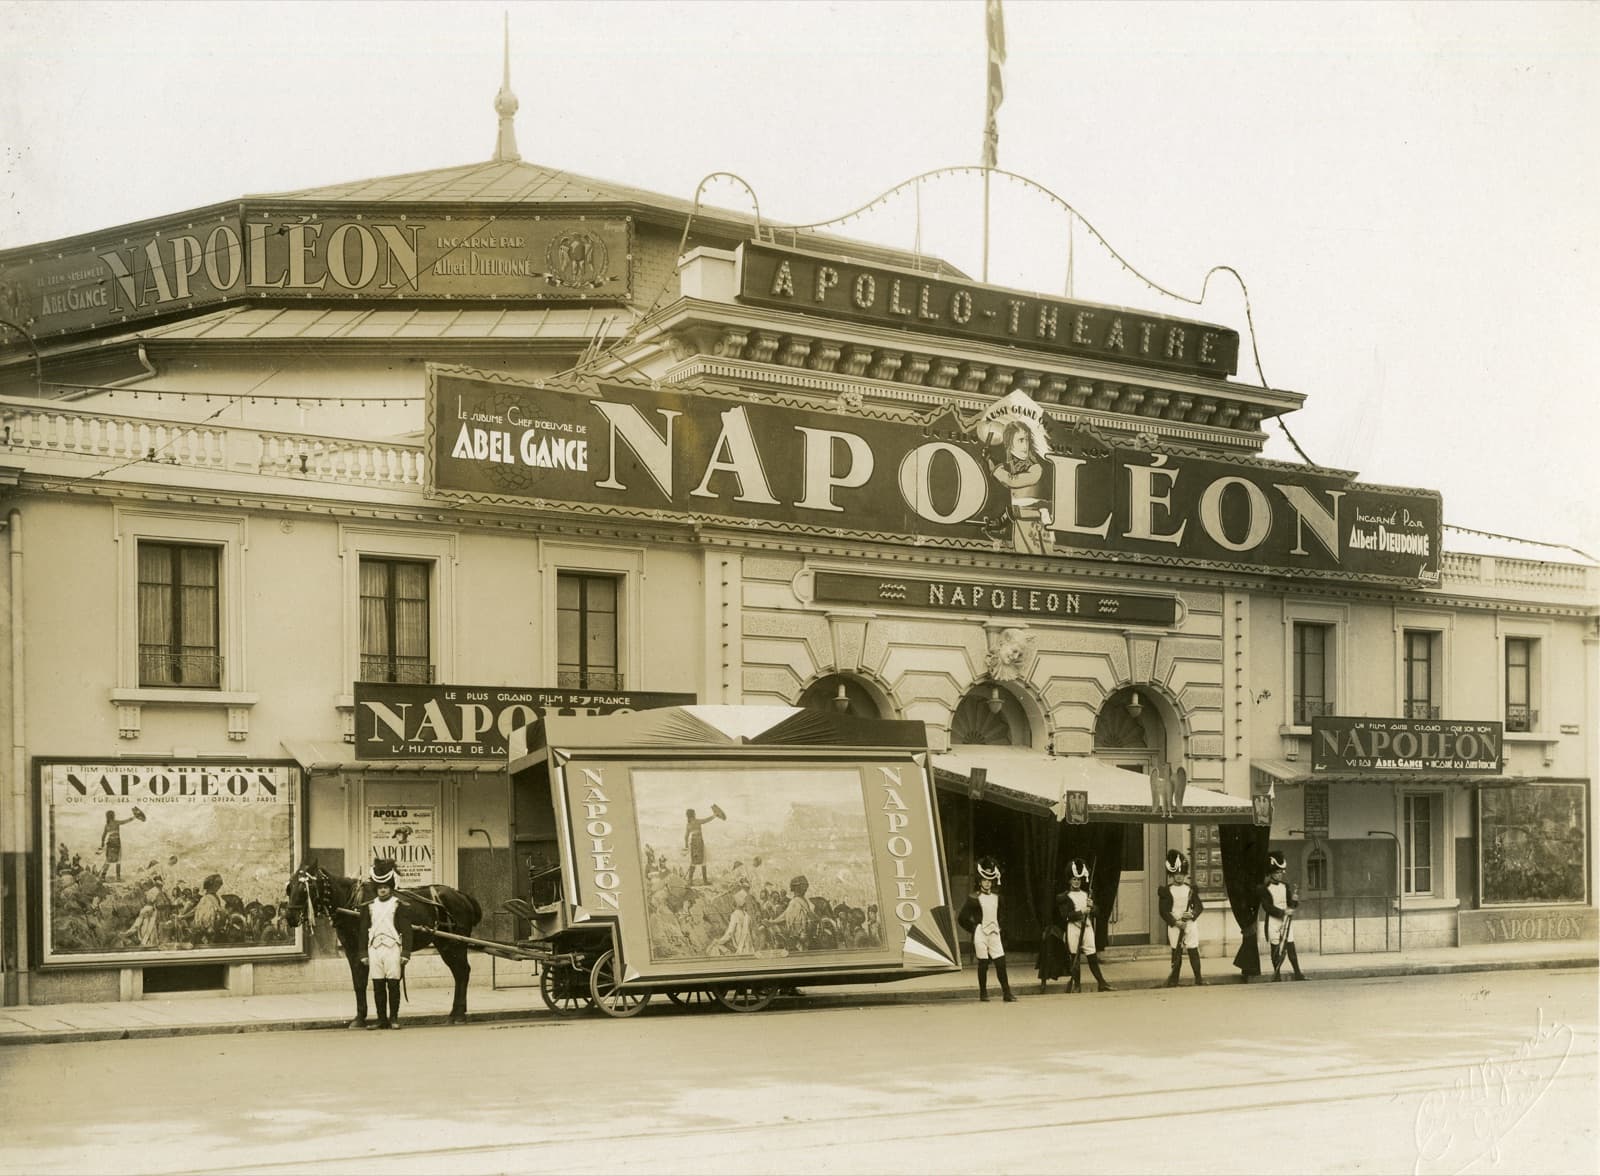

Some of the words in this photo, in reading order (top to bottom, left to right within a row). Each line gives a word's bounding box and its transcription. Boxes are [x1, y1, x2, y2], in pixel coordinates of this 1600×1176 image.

[499, 236, 525, 248] PAR
[99, 215, 425, 313] NAPOLÉON
[67, 286, 107, 310] GANCE
[576, 424, 587, 434] DE
[451, 422, 515, 465] ABEL
[520, 428, 588, 472] GANCE
[589, 398, 1347, 564] NAPOLÉON
[1349, 524, 1378, 550] Albert
[928, 583, 1080, 613] NAPOLEON
[445, 692, 457, 700] LE
[466, 692, 489, 701] PLUS
[497, 693, 532, 702] GRAND
[539, 694, 563, 703] FILM
[593, 696, 631, 705] FRANCE
[470, 745, 484, 754] DE
[1319, 728, 1497, 759] NAPOLEON
[1375, 758, 1397, 768] ABEL
[1398, 758, 1423, 768] GANCE
[373, 810, 408, 818] APOLLO
[580, 767, 622, 911] NAPOLEON
[1485, 917, 1582, 940] NAPOLEON
